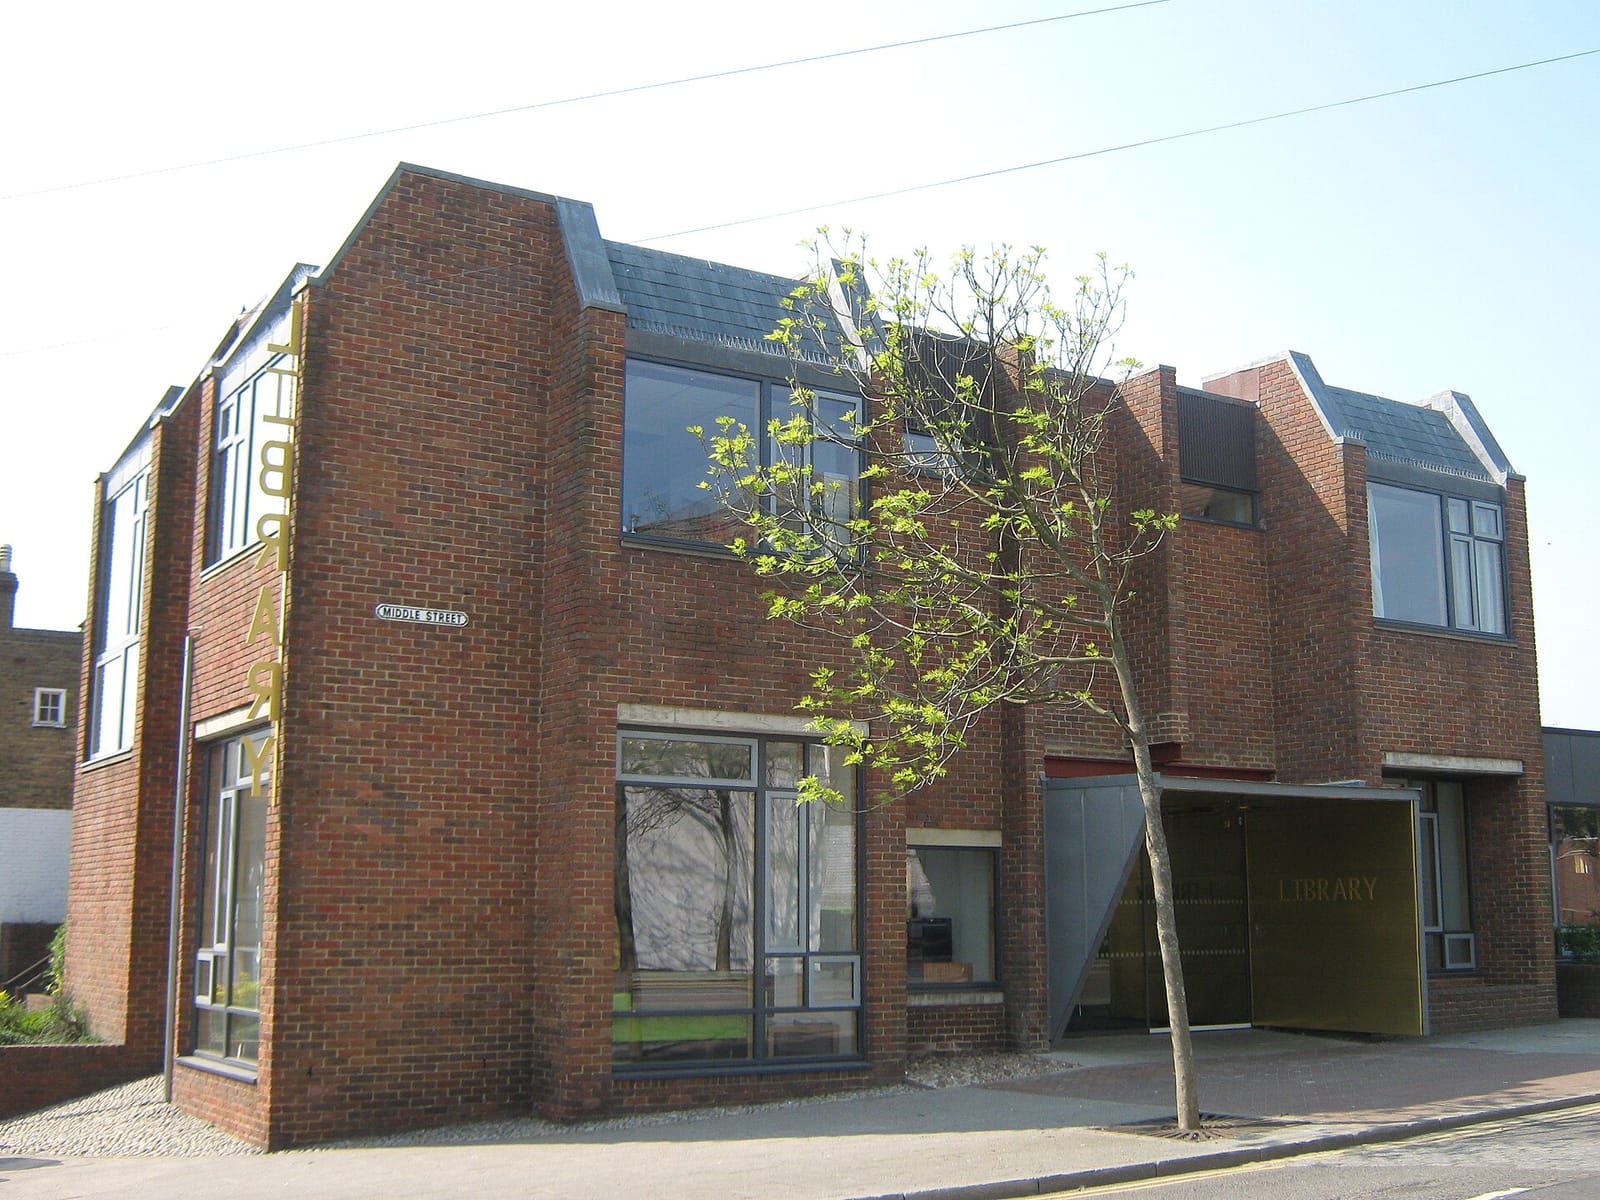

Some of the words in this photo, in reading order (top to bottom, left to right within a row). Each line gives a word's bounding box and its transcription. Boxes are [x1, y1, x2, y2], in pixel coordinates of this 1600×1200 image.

[383, 607, 421, 619] MIDDLE
[427, 611, 462, 623] STREET
[1280, 877, 1377, 901] LIBRARY
